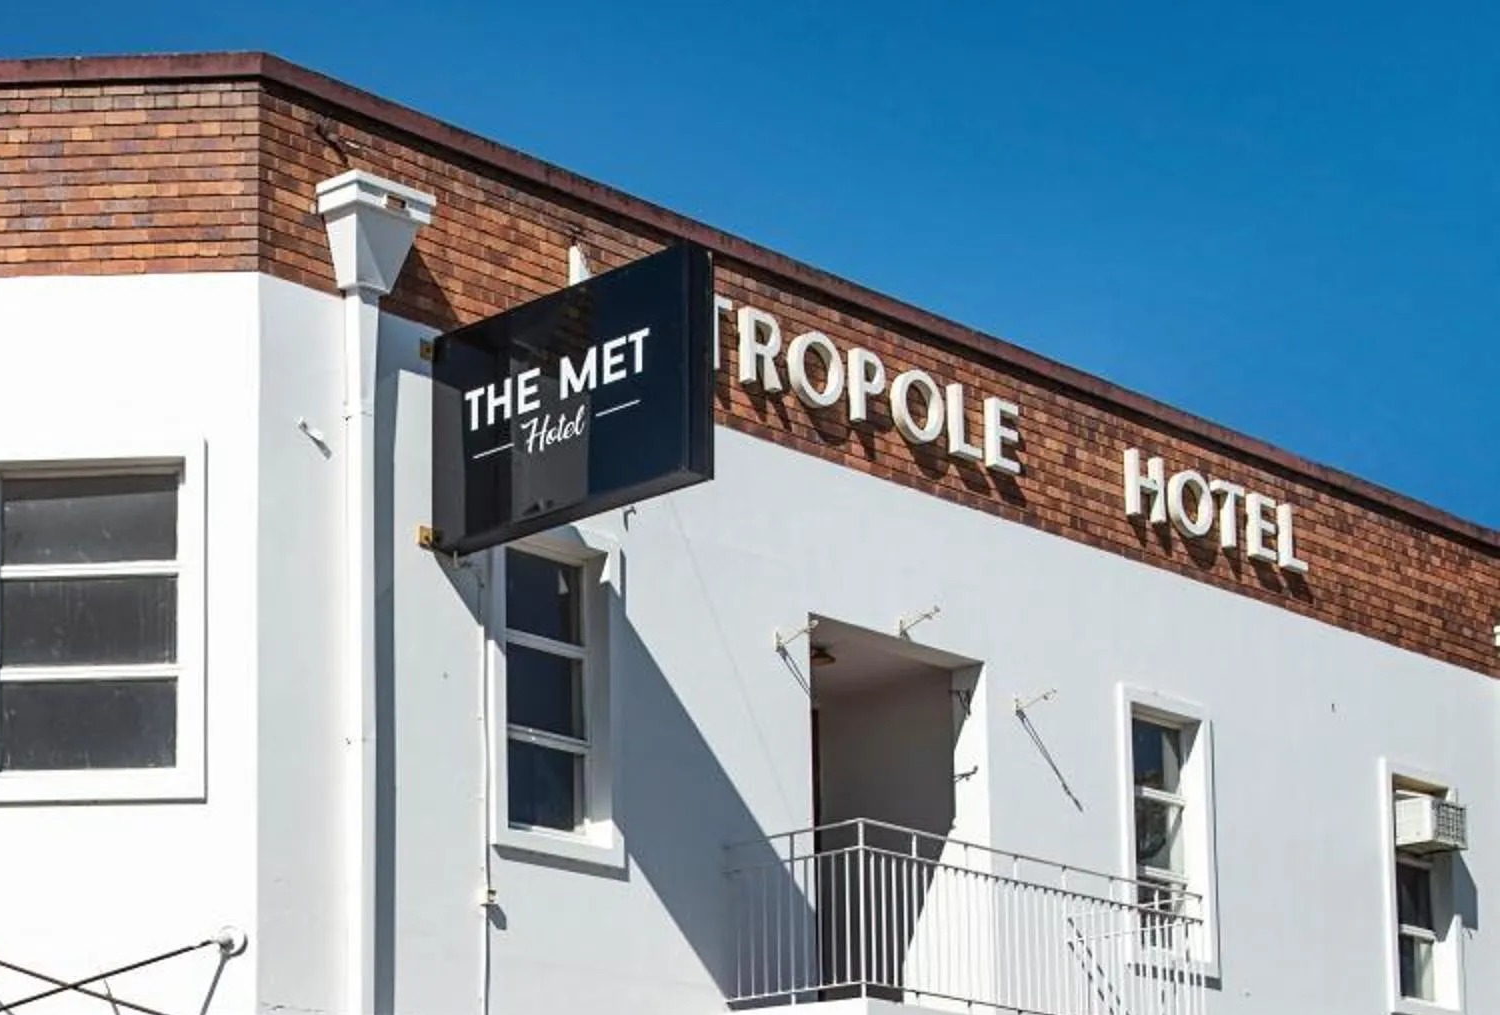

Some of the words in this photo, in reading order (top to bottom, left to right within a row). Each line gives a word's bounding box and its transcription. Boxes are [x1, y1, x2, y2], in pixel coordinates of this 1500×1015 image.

[465, 368, 541, 431] THE
[560, 327, 650, 400] MET
[520, 404, 587, 453] Hotel
[713, 294, 1021, 474] TROPOLE
[1123, 448, 1309, 572] HOTEL
